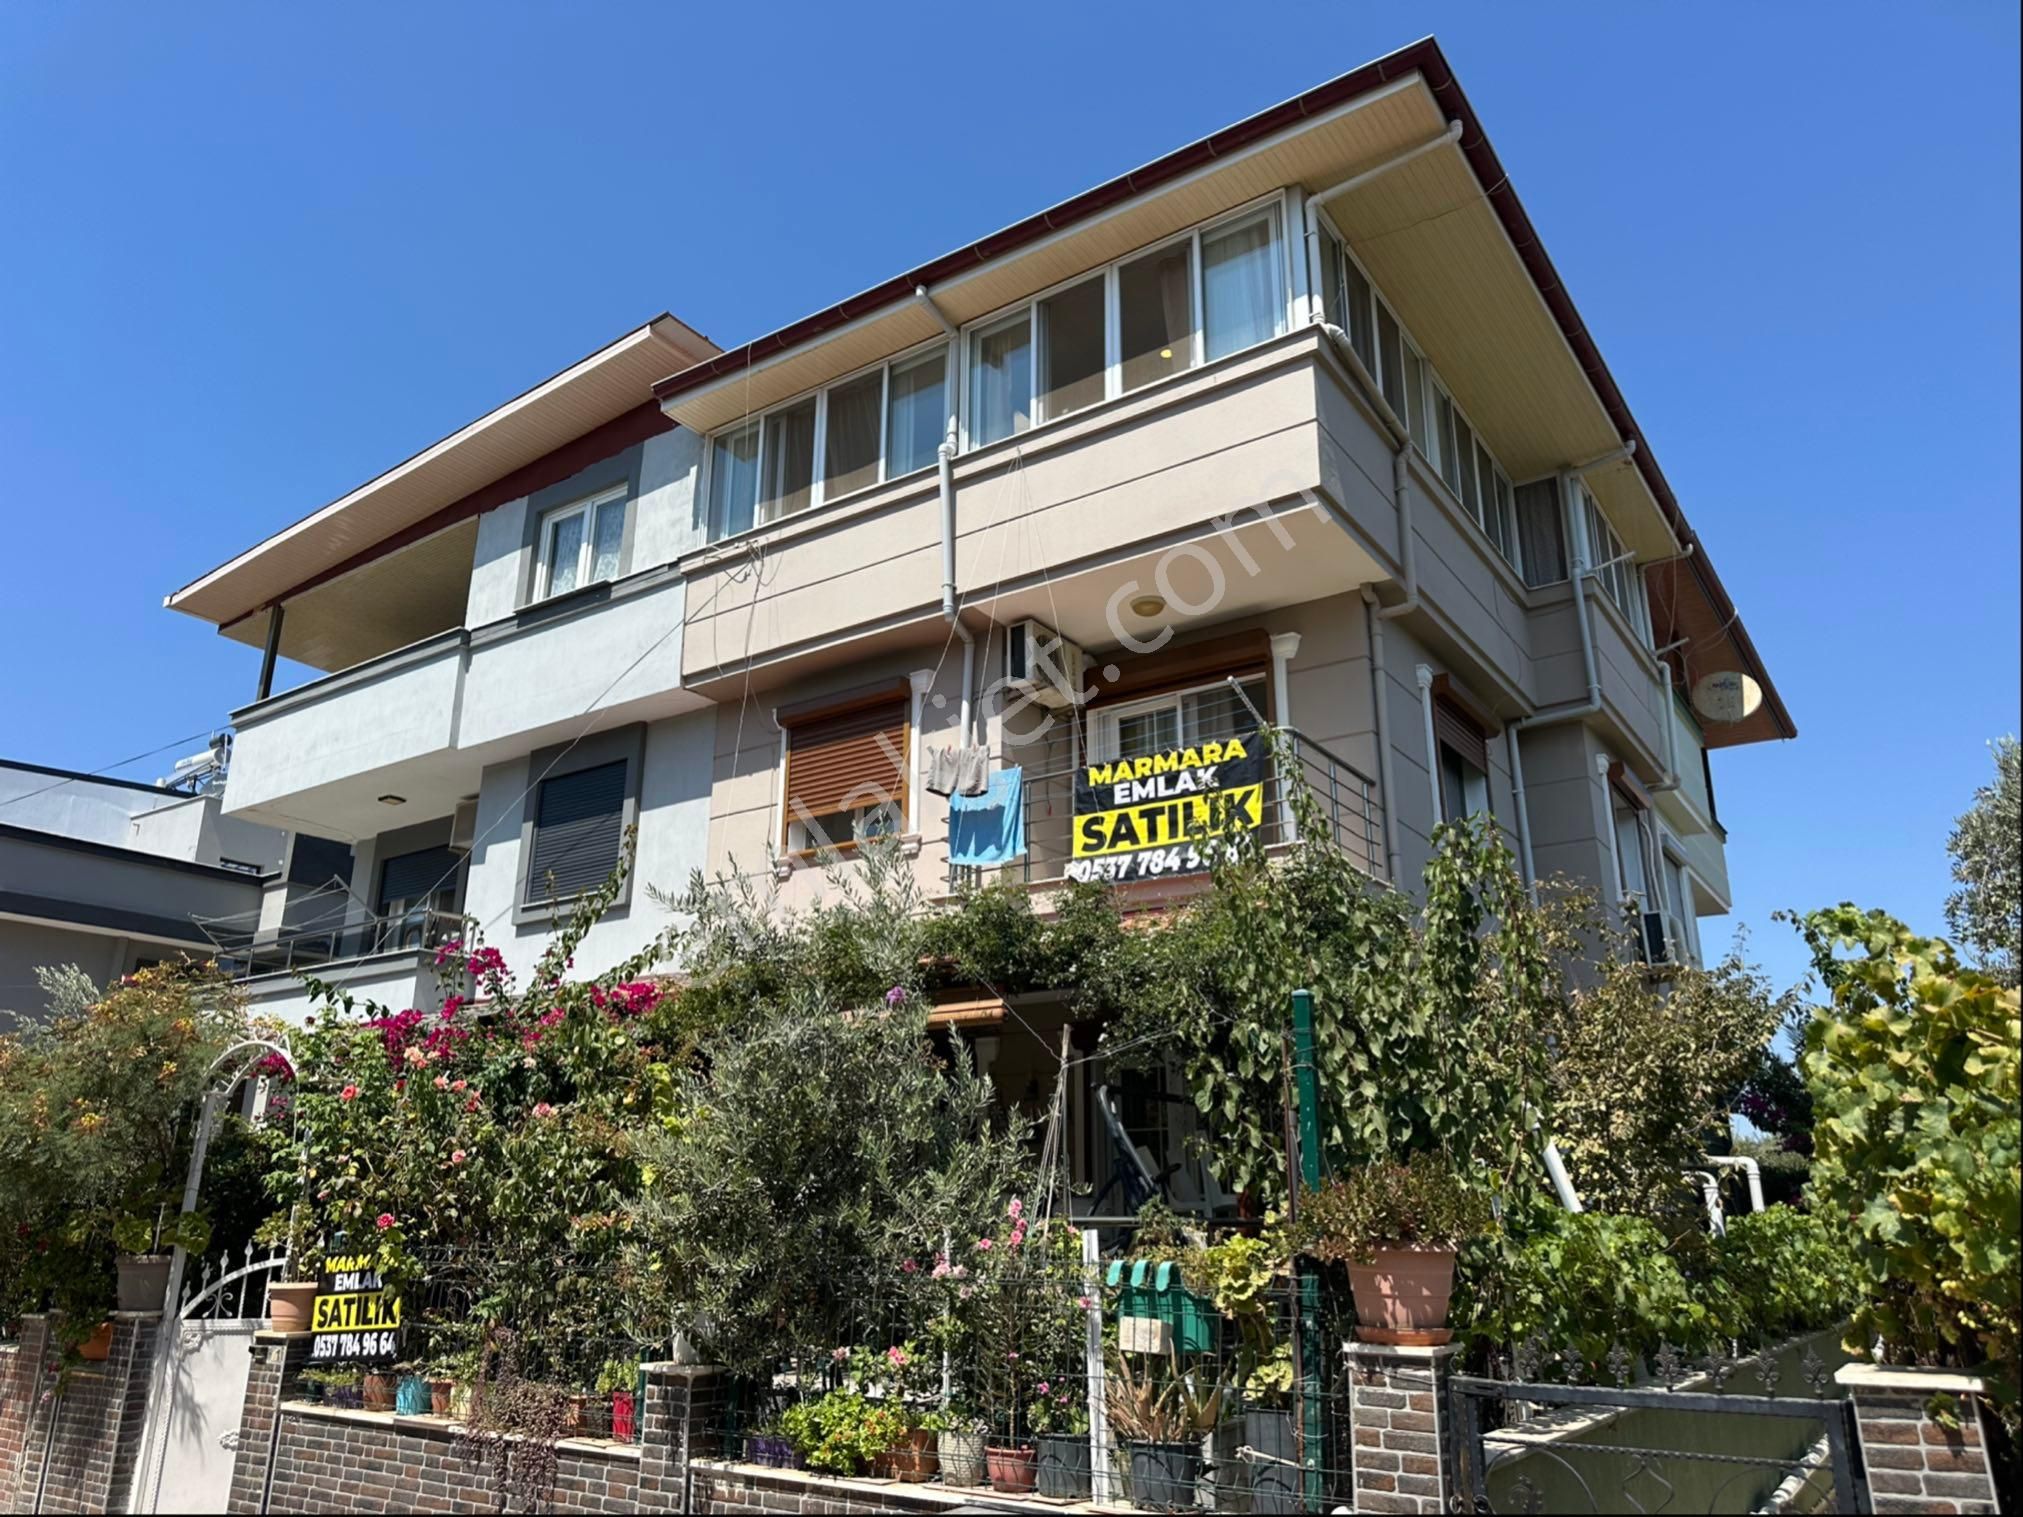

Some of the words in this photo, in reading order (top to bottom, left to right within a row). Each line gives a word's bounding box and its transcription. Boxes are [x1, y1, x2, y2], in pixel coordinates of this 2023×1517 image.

[1088, 738, 1248, 787] MARMARA
[1113, 766, 1220, 805] EMLAK
[1081, 788, 1256, 852] SATILIK
[1077, 854, 1133, 882] 0537
[1137, 845, 1182, 876] 784
[334, 1271, 383, 1292] EMLAK
[317, 1296, 398, 1329] SATILIK
[313, 1334, 338, 1358] 0537
[340, 1332, 360, 1356] 784
[362, 1331, 378, 1356] 96
[379, 1331, 396, 1355] 64
